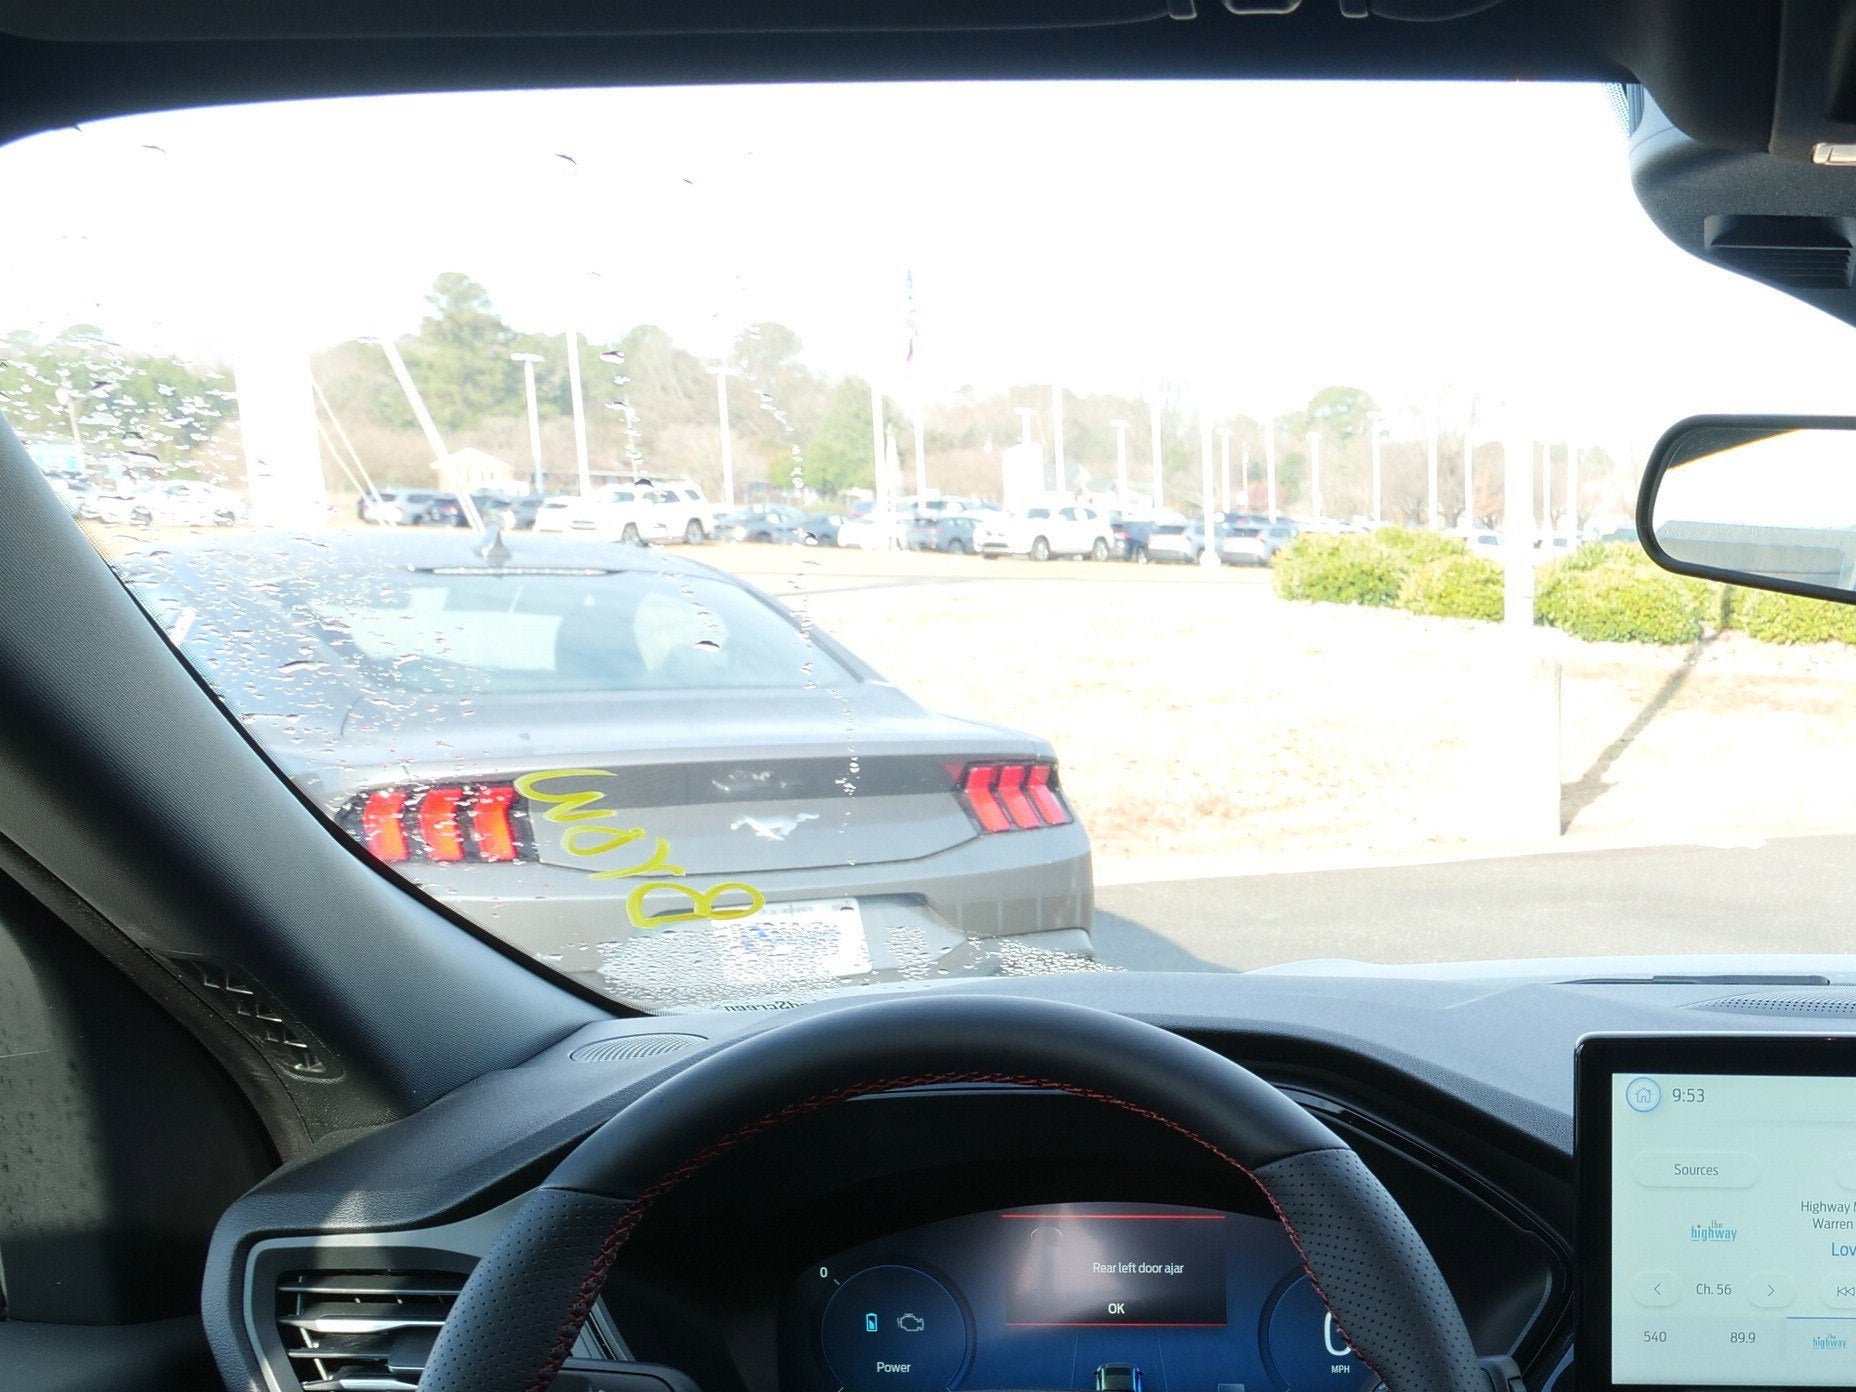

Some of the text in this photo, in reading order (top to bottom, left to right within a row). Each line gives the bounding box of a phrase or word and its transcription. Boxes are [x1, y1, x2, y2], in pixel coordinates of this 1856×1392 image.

[1672, 1088, 1705, 1103] 9:53
[1674, 1164, 1719, 1177] Sources
[1800, 1201, 1850, 1216] Highway
[1813, 1218, 1853, 1231] Warren
[1691, 1224, 1737, 1241] highway
[1093, 1262, 1184, 1276] Rear left door ajar
[1696, 1282, 1732, 1296] Ch. 56
[1108, 1303, 1125, 1314] OK
[1644, 1330, 1667, 1343] 540
[1730, 1331, 1756, 1344] 89.9
[876, 1361, 912, 1373] Power
[1331, 1365, 1350, 1374] MPH
